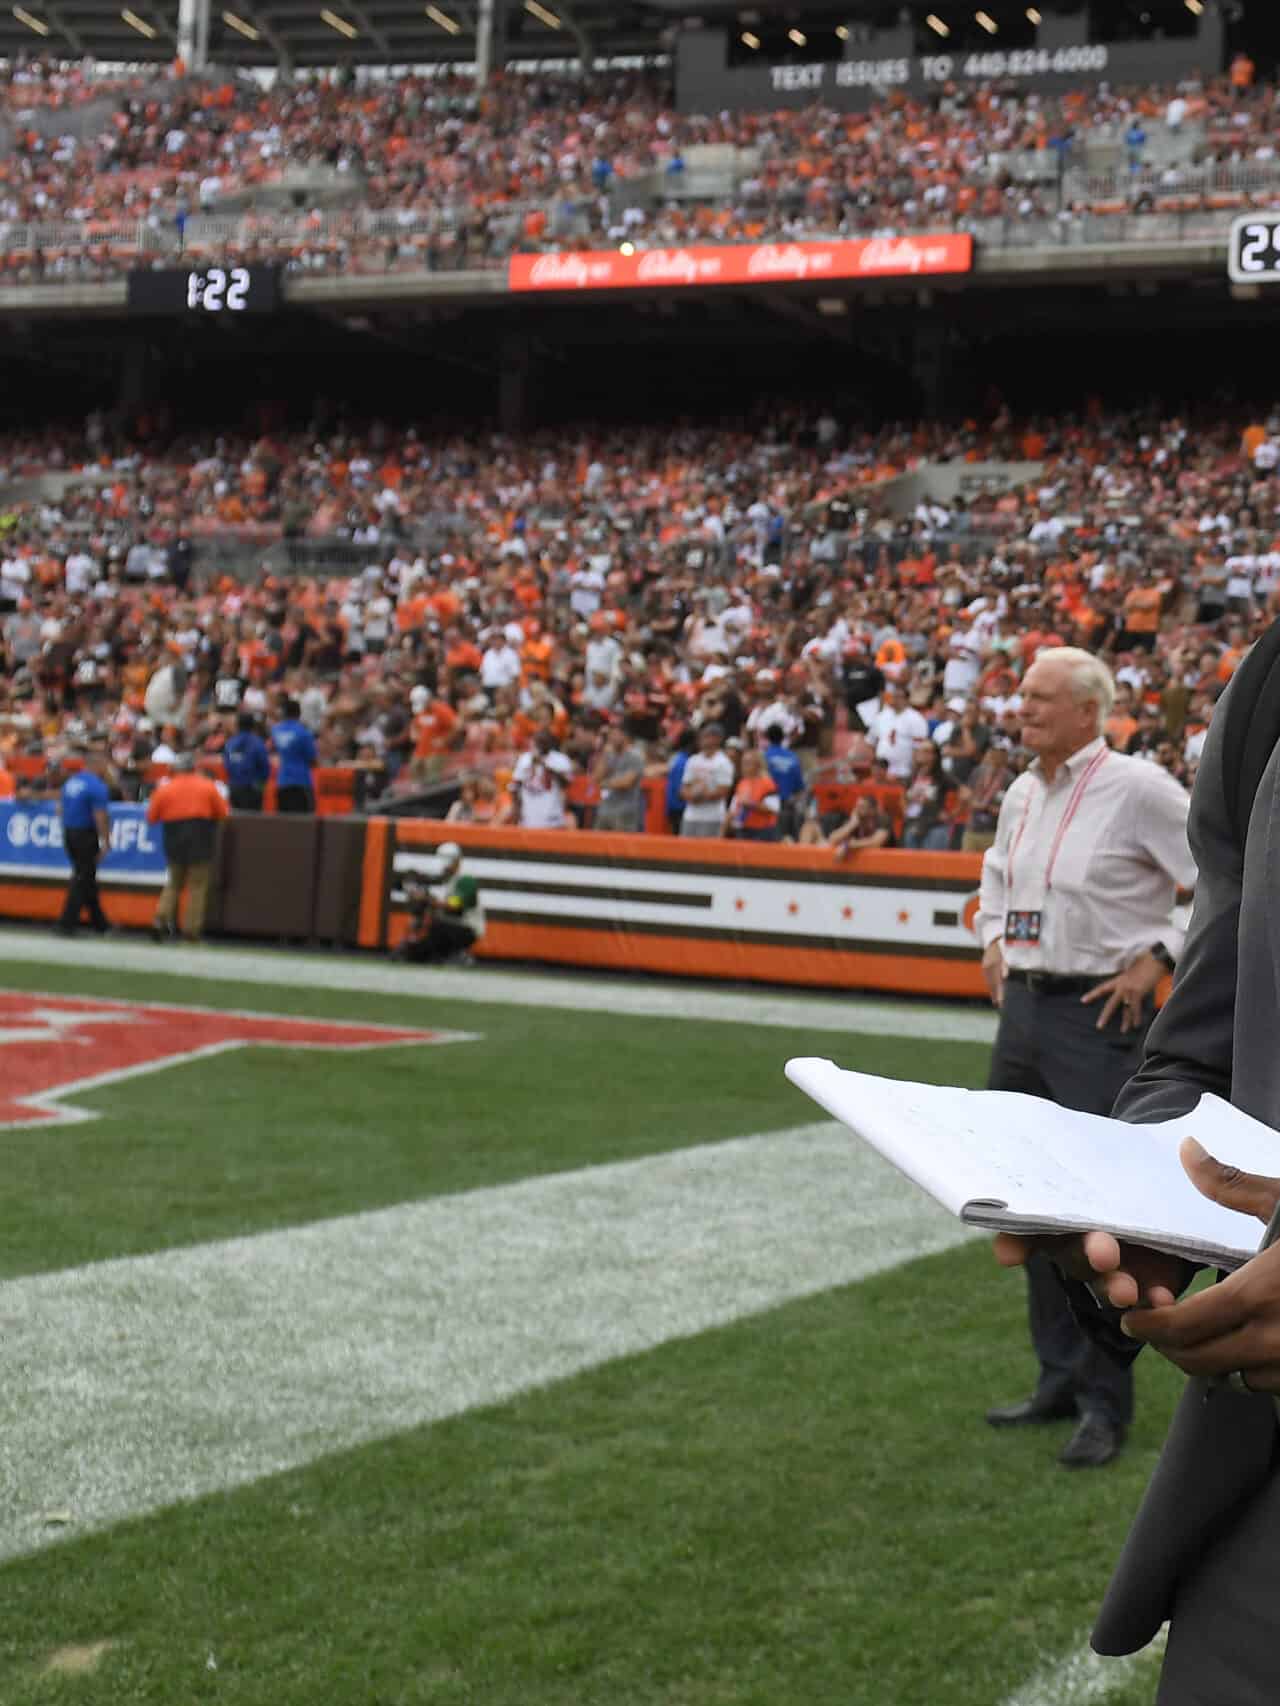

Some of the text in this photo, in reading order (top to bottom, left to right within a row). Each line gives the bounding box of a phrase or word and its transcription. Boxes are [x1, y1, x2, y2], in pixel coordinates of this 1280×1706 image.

[771, 63, 824, 91] TEXT
[836, 58, 909, 87] ISSUES
[921, 54, 953, 81] TO
[187, 267, 250, 311] 1:22
